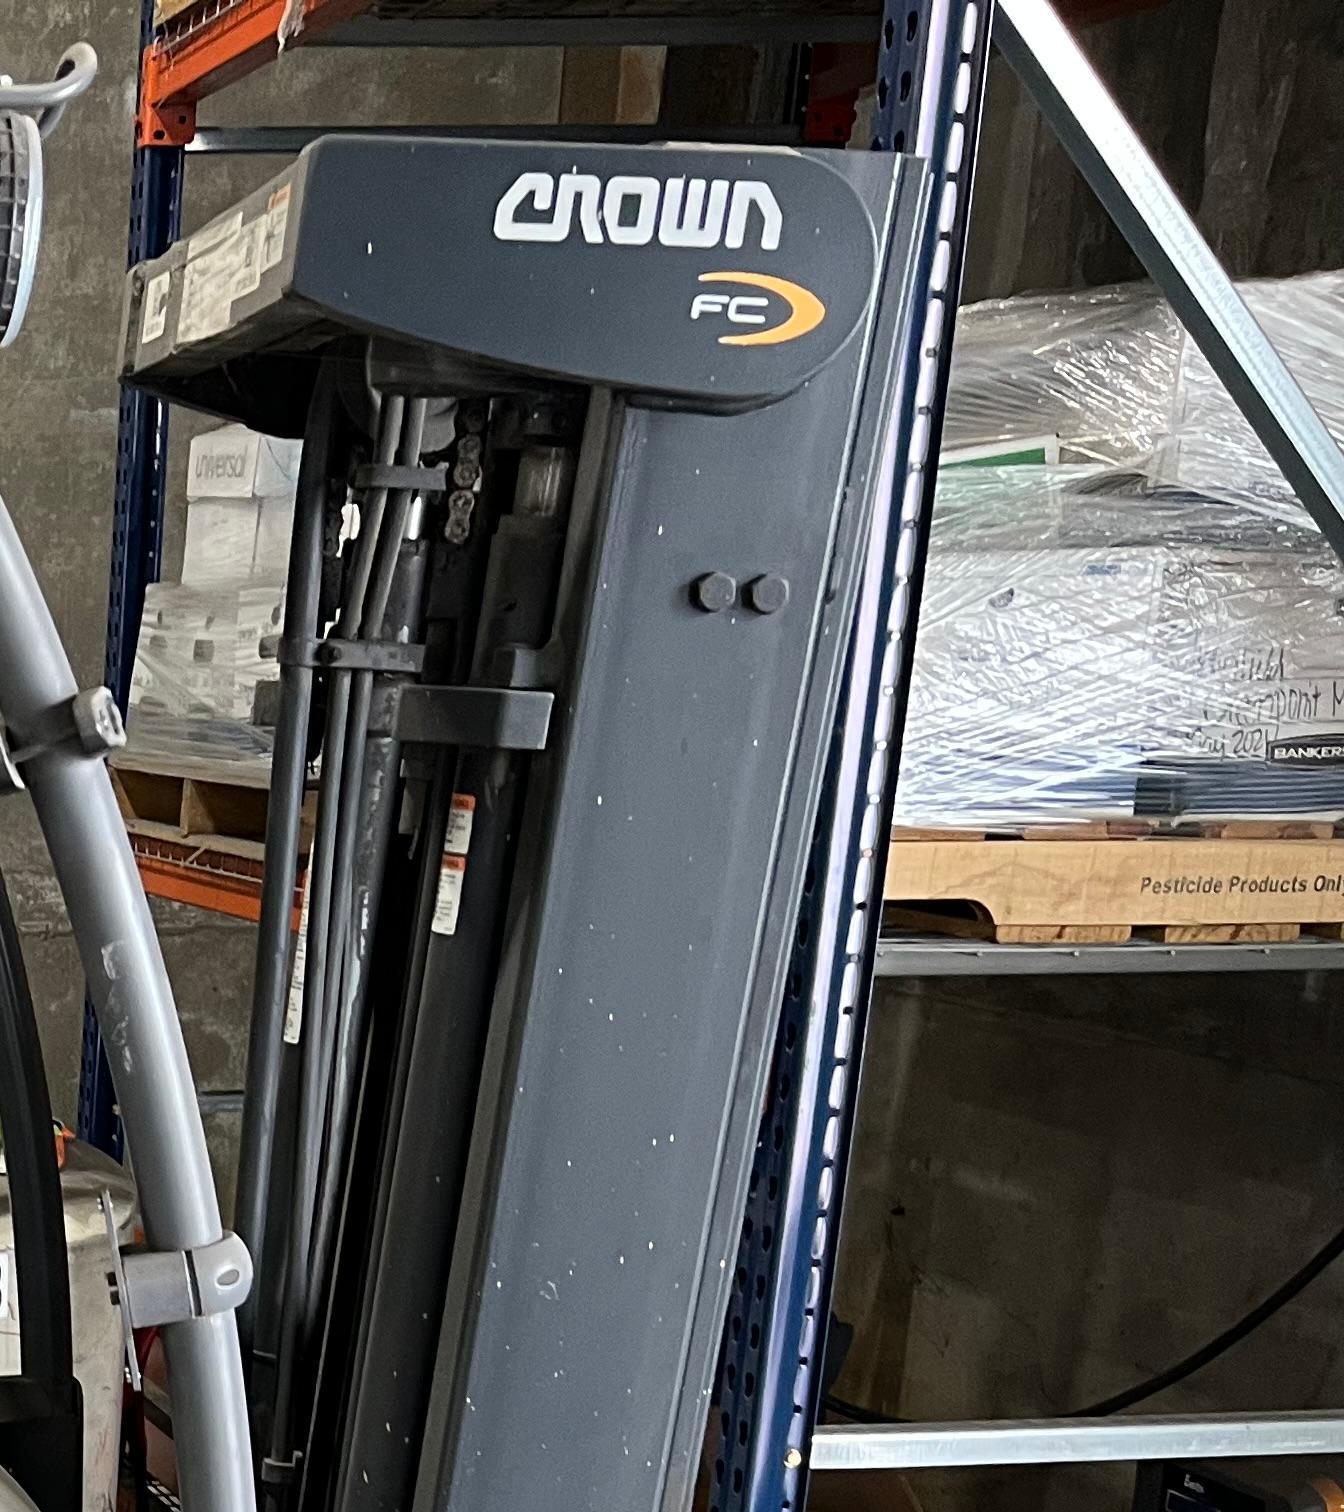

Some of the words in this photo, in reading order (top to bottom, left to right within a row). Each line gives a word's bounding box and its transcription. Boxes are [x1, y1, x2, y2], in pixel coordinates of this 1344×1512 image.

[493, 172, 783, 250] CROWN
[690, 294, 769, 323] FC
[1274, 746, 1344, 759] BANKER
[1140, 876, 1223, 895] Pesticide
[1229, 875, 1307, 894] Products
